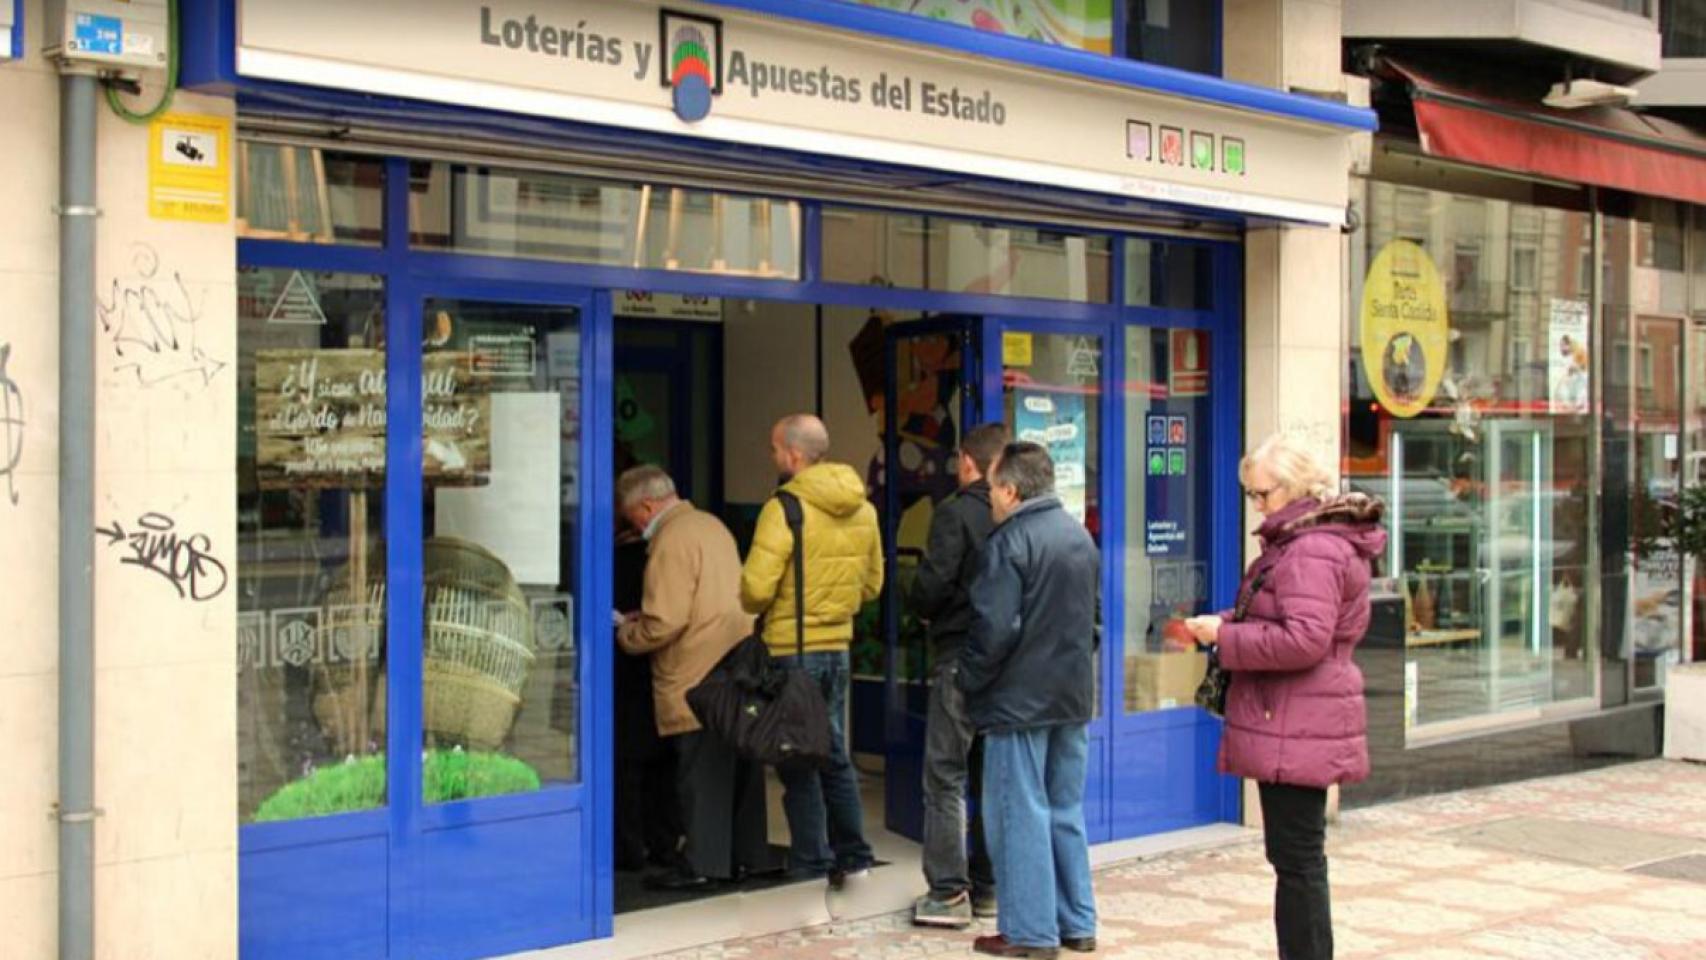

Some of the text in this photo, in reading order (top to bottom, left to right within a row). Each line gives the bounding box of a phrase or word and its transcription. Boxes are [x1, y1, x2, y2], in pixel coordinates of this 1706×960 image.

[480, 6, 1006, 126] Loterías y Apuestas del Estado
